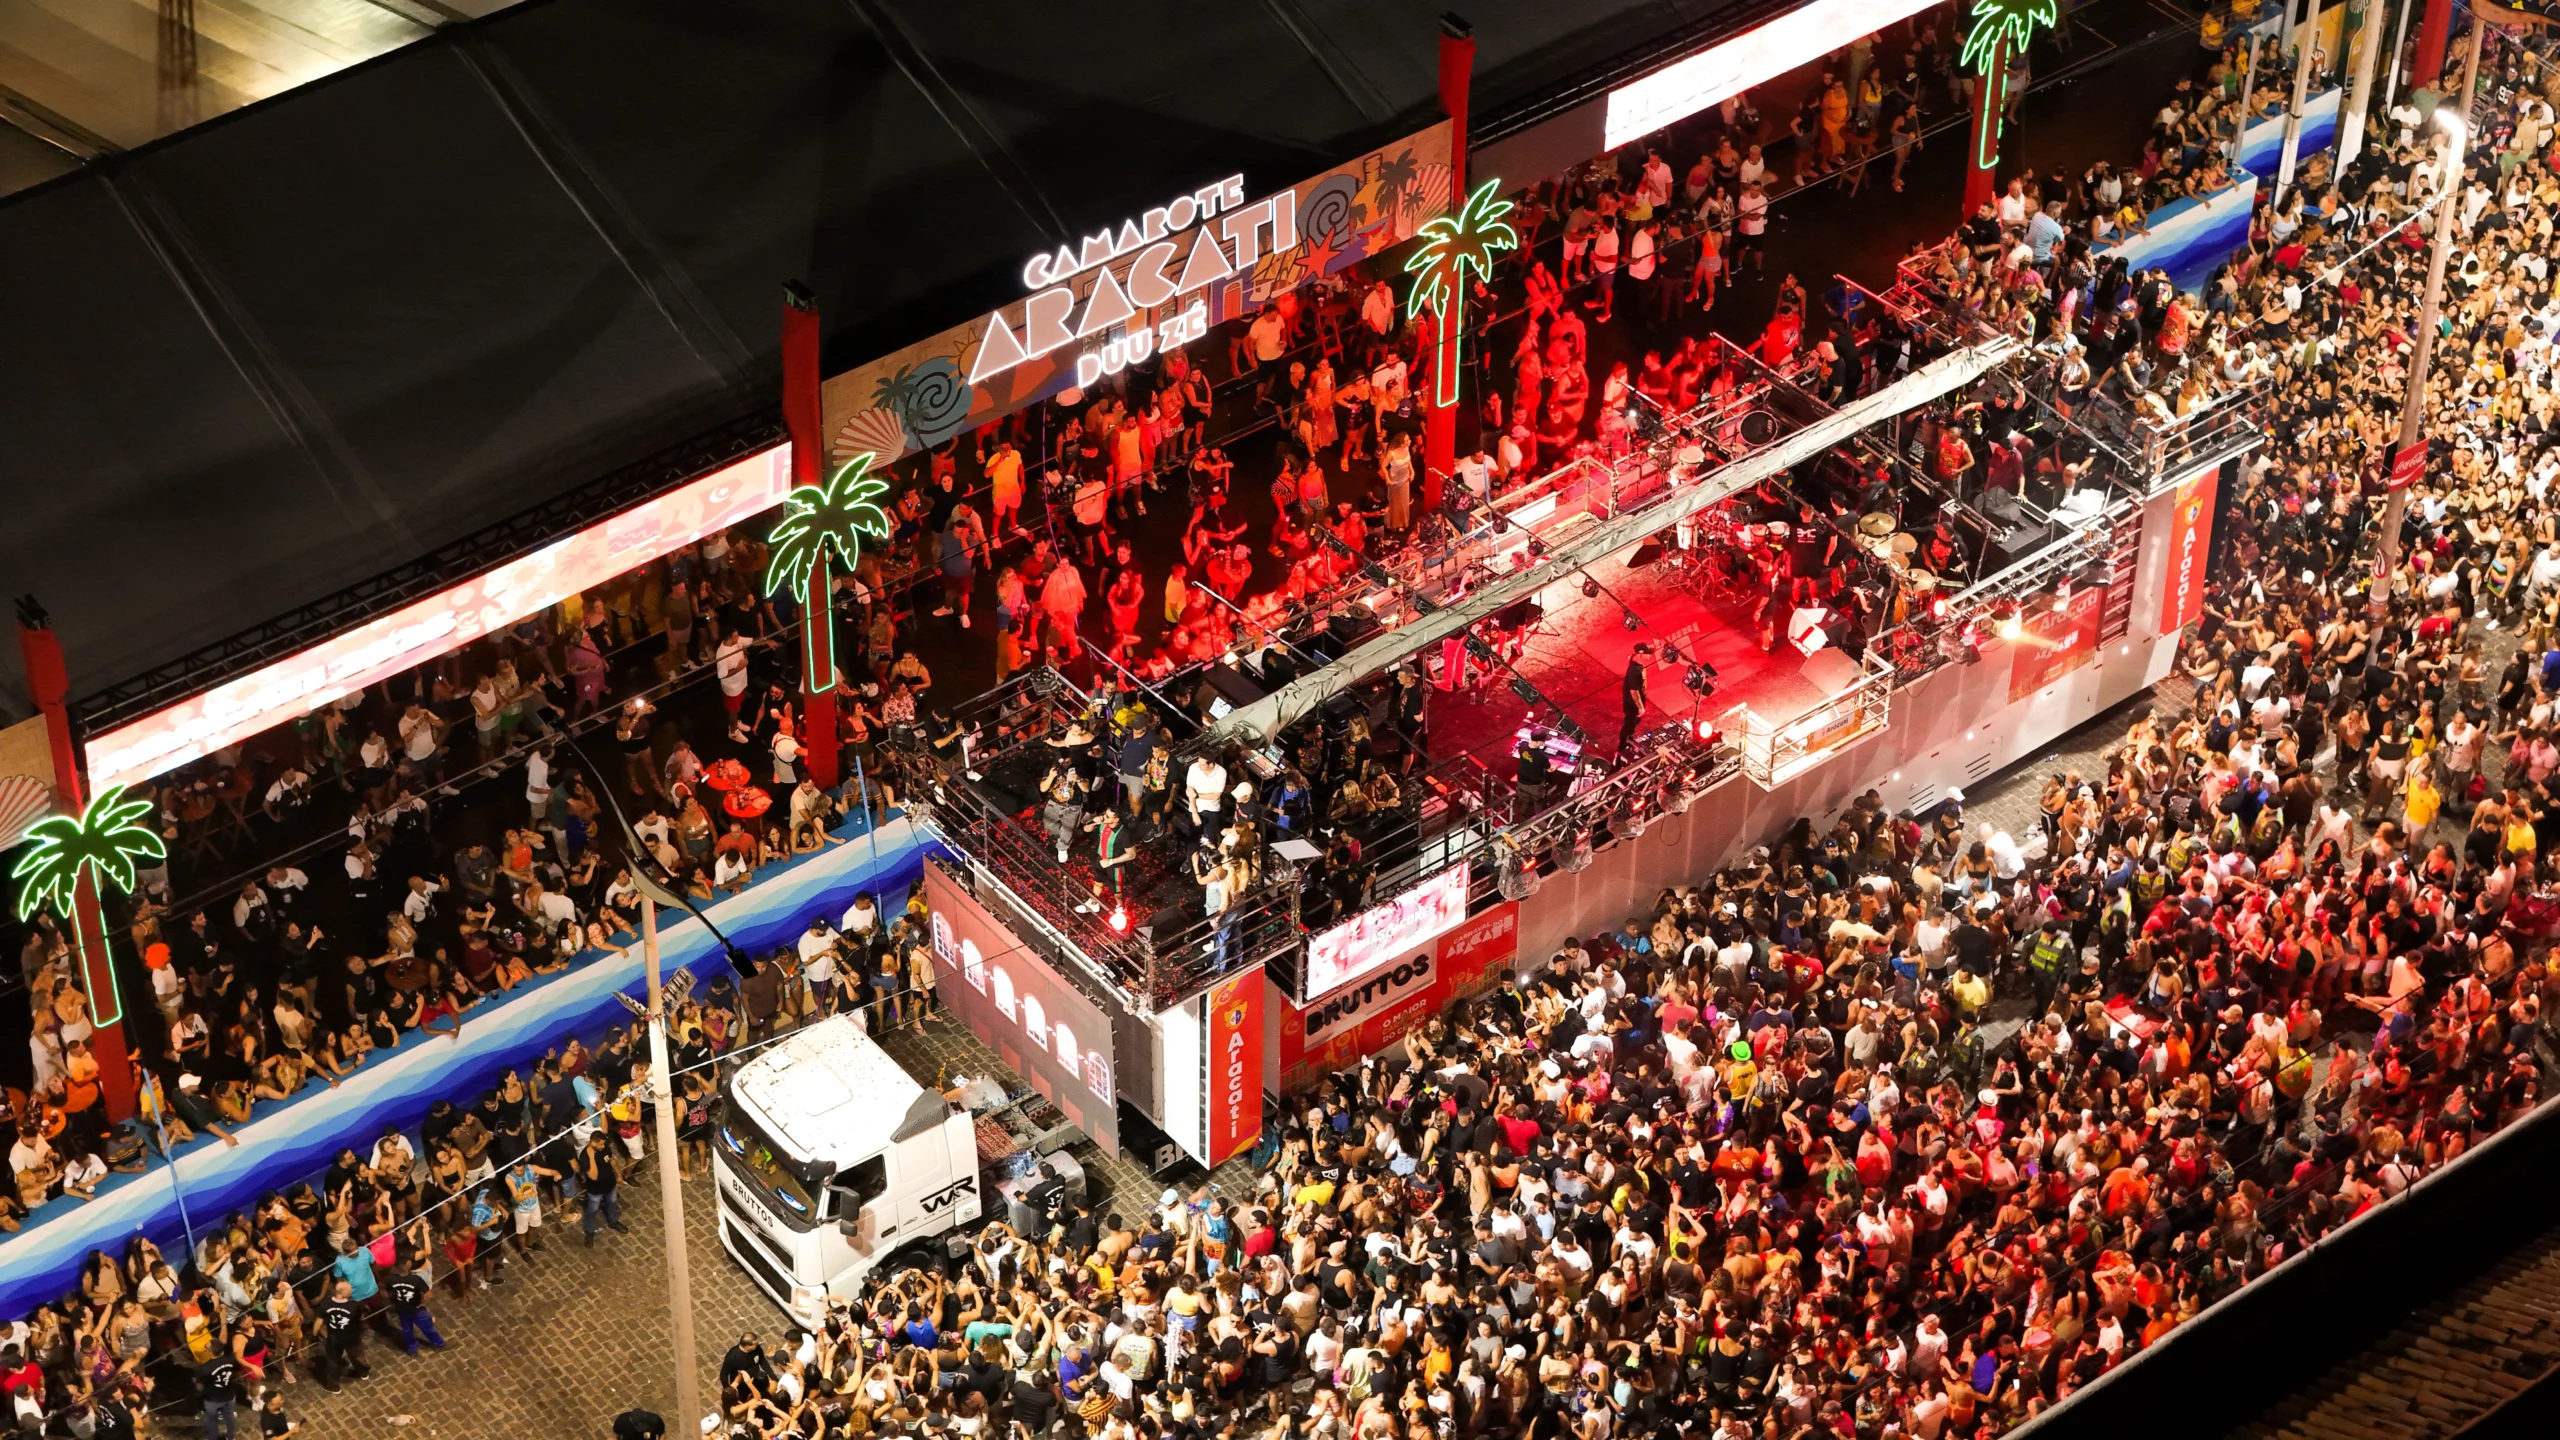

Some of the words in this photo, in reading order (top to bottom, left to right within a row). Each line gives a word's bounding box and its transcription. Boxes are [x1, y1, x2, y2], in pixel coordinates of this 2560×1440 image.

[1024, 173, 1244, 289] CAMAROTE
[968, 189, 1297, 385] ARACATI
[1077, 327, 1153, 388] DUU
[1158, 299, 1208, 353] ZÉ
[2039, 588, 2099, 630] Aracati
[2176, 527, 2196, 628] Aracati
[1446, 914, 1513, 959] ARACATI
[1306, 953, 1430, 1036] BRUTTOS
[1382, 1018, 1391, 1028] O
[1382, 1031, 1396, 1044] DO
[1228, 1031, 1245, 1139] Aracati
[732, 1178, 774, 1228] BRUTTOS
